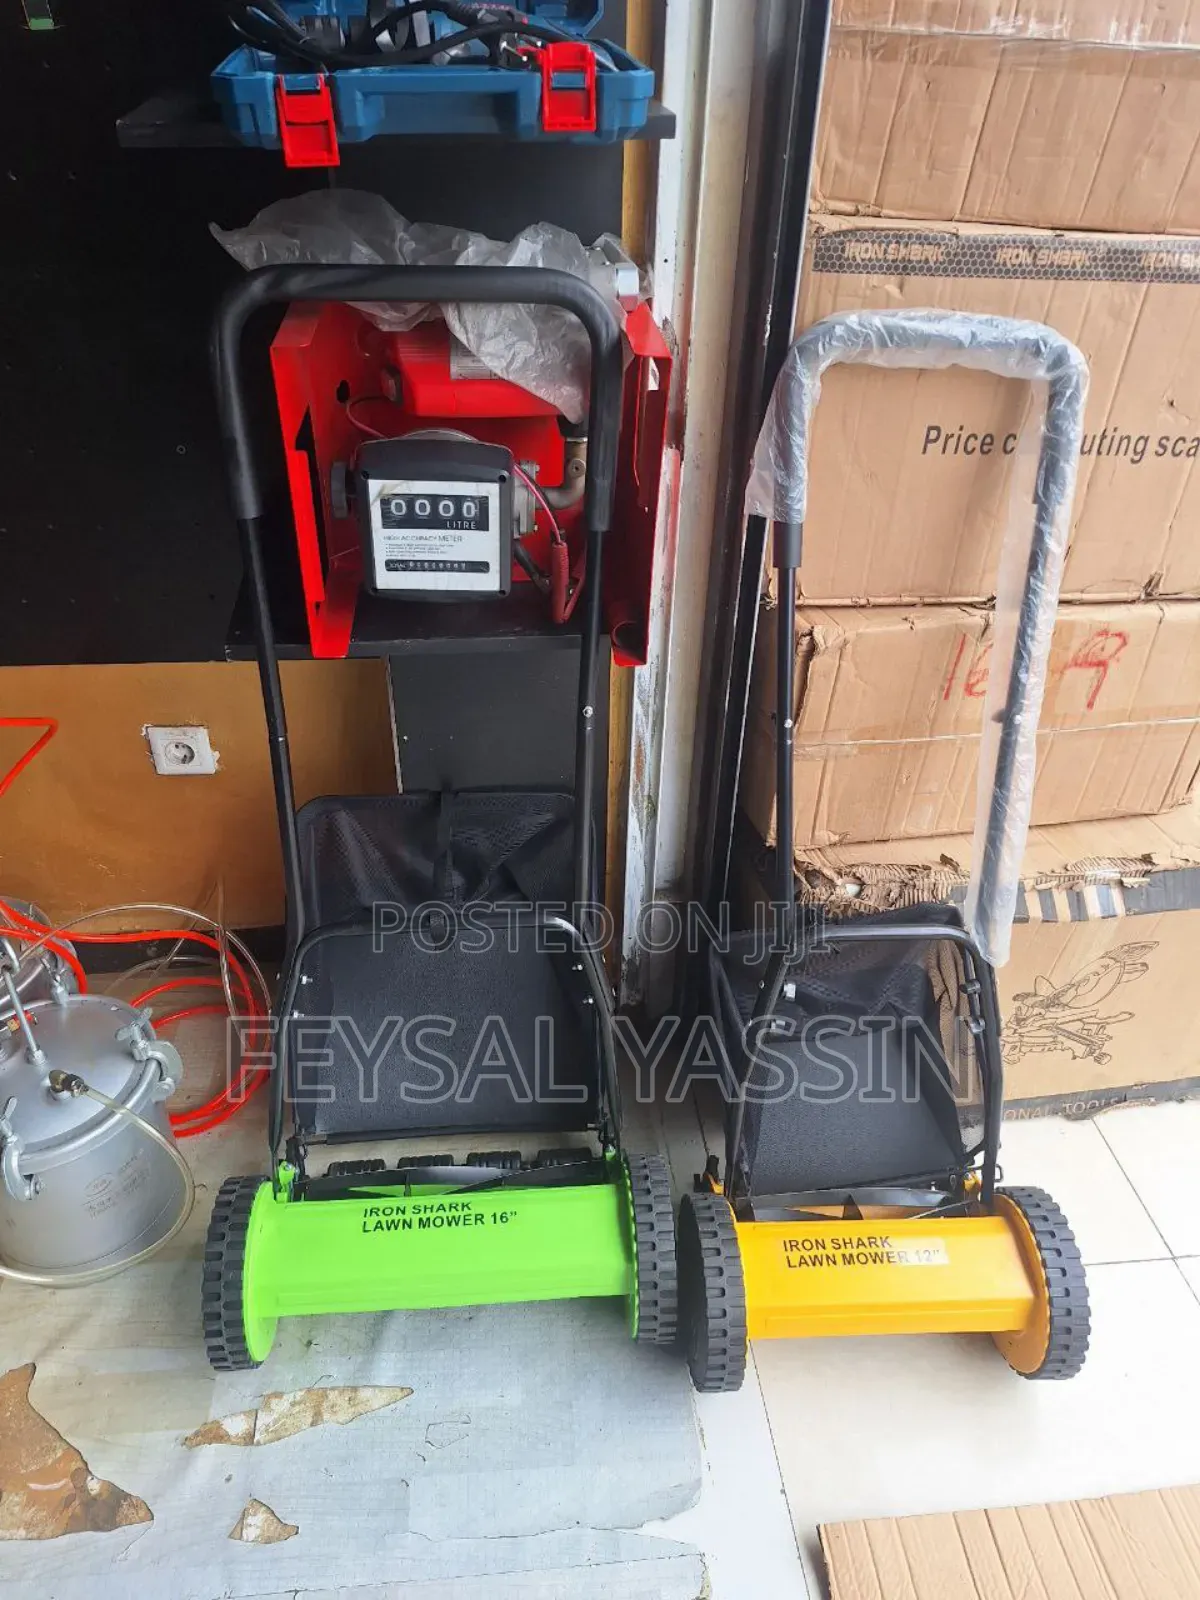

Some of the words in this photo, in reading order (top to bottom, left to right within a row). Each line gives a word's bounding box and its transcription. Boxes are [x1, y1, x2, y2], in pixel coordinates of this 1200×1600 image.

[995, 246, 1034, 267] IRON
[921, 424, 995, 456] Price
[446, 520, 477, 530] LITRE
[438, 534, 463, 542] METER
[363, 1206, 406, 1218] IRON
[411, 1202, 472, 1215] SHARK
[361, 1218, 413, 1233] LAWN
[417, 1213, 485, 1229] MOWER
[783, 1238, 826, 1252] IRON
[830, 1236, 893, 1250] SHARK
[786, 1254, 837, 1268] LAWN
[841, 1250, 911, 1265] MOWER
